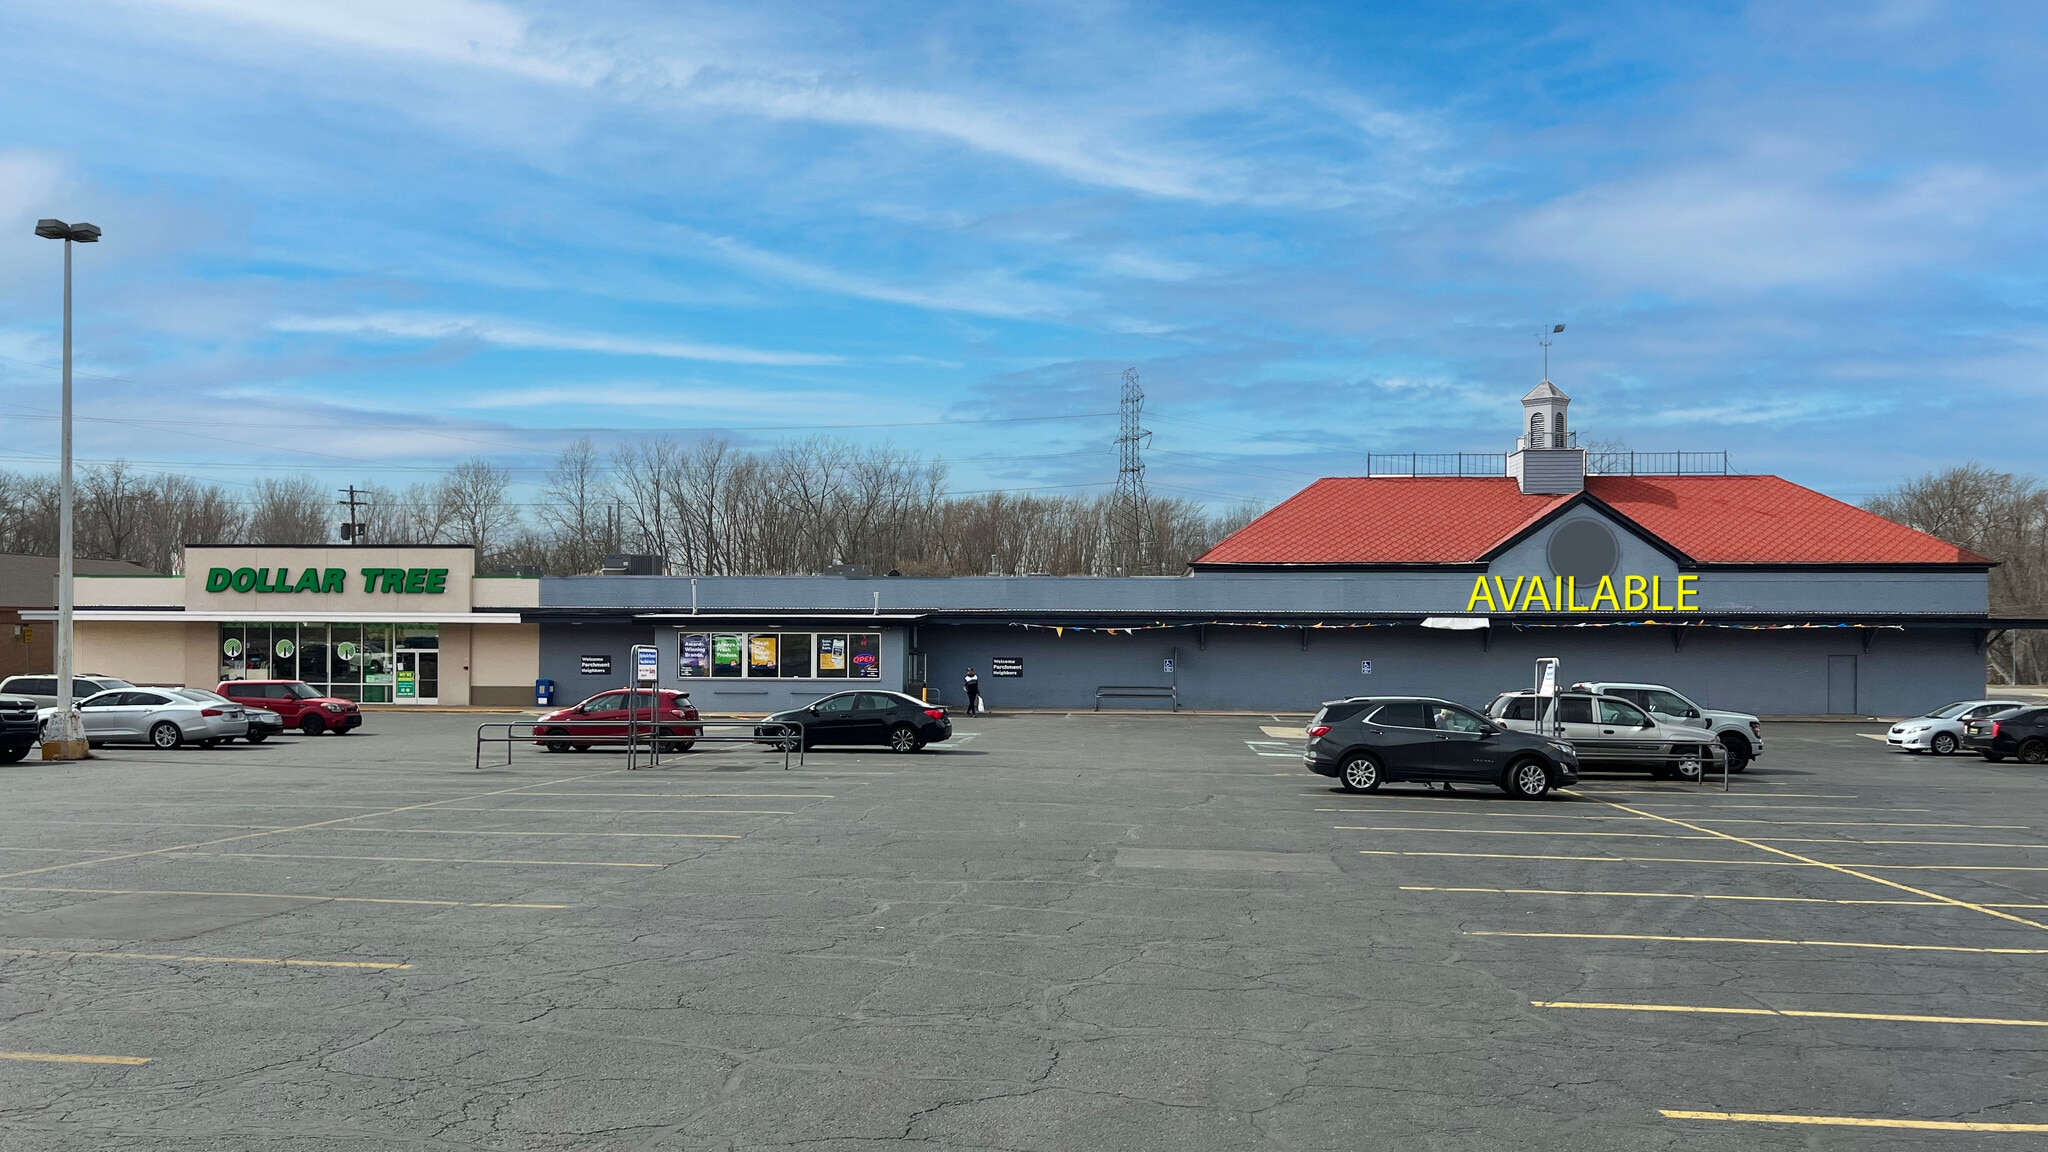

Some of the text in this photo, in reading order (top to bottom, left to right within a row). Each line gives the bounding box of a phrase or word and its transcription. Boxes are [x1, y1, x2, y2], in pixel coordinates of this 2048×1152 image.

[205, 567, 449, 594] DOLLAR TREE
[853, 655, 876, 663] OPEN
